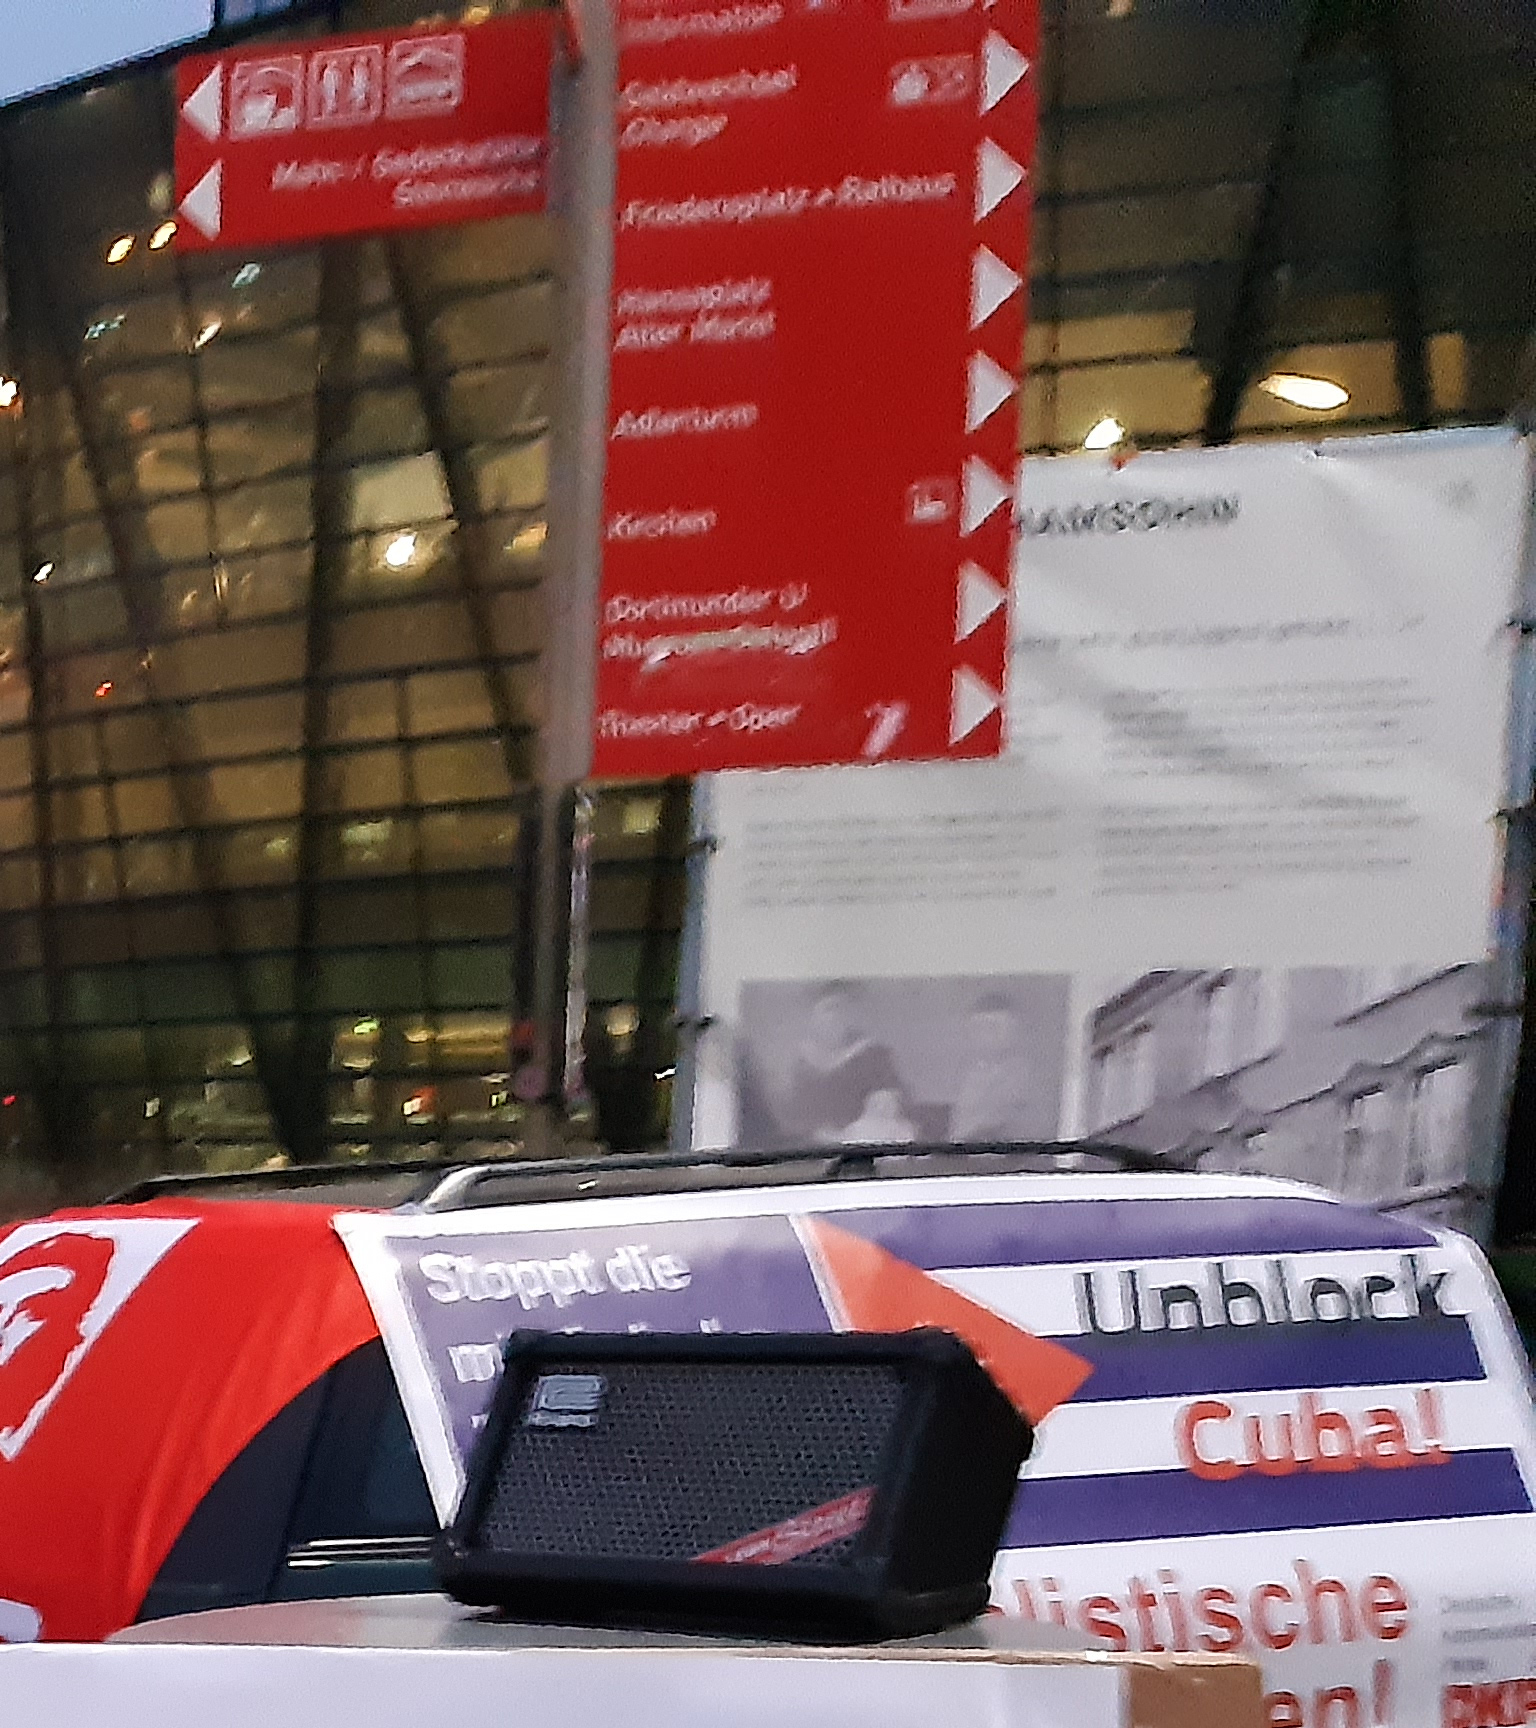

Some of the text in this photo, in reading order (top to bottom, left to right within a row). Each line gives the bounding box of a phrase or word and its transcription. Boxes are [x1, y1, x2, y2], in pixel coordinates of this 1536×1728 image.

[419, 1245, 693, 1311] Stoppt die
[1073, 1253, 1466, 1338] Unblock
[1171, 1386, 1452, 1481] Cuba!
[986, 1558, 1411, 1652] listische
